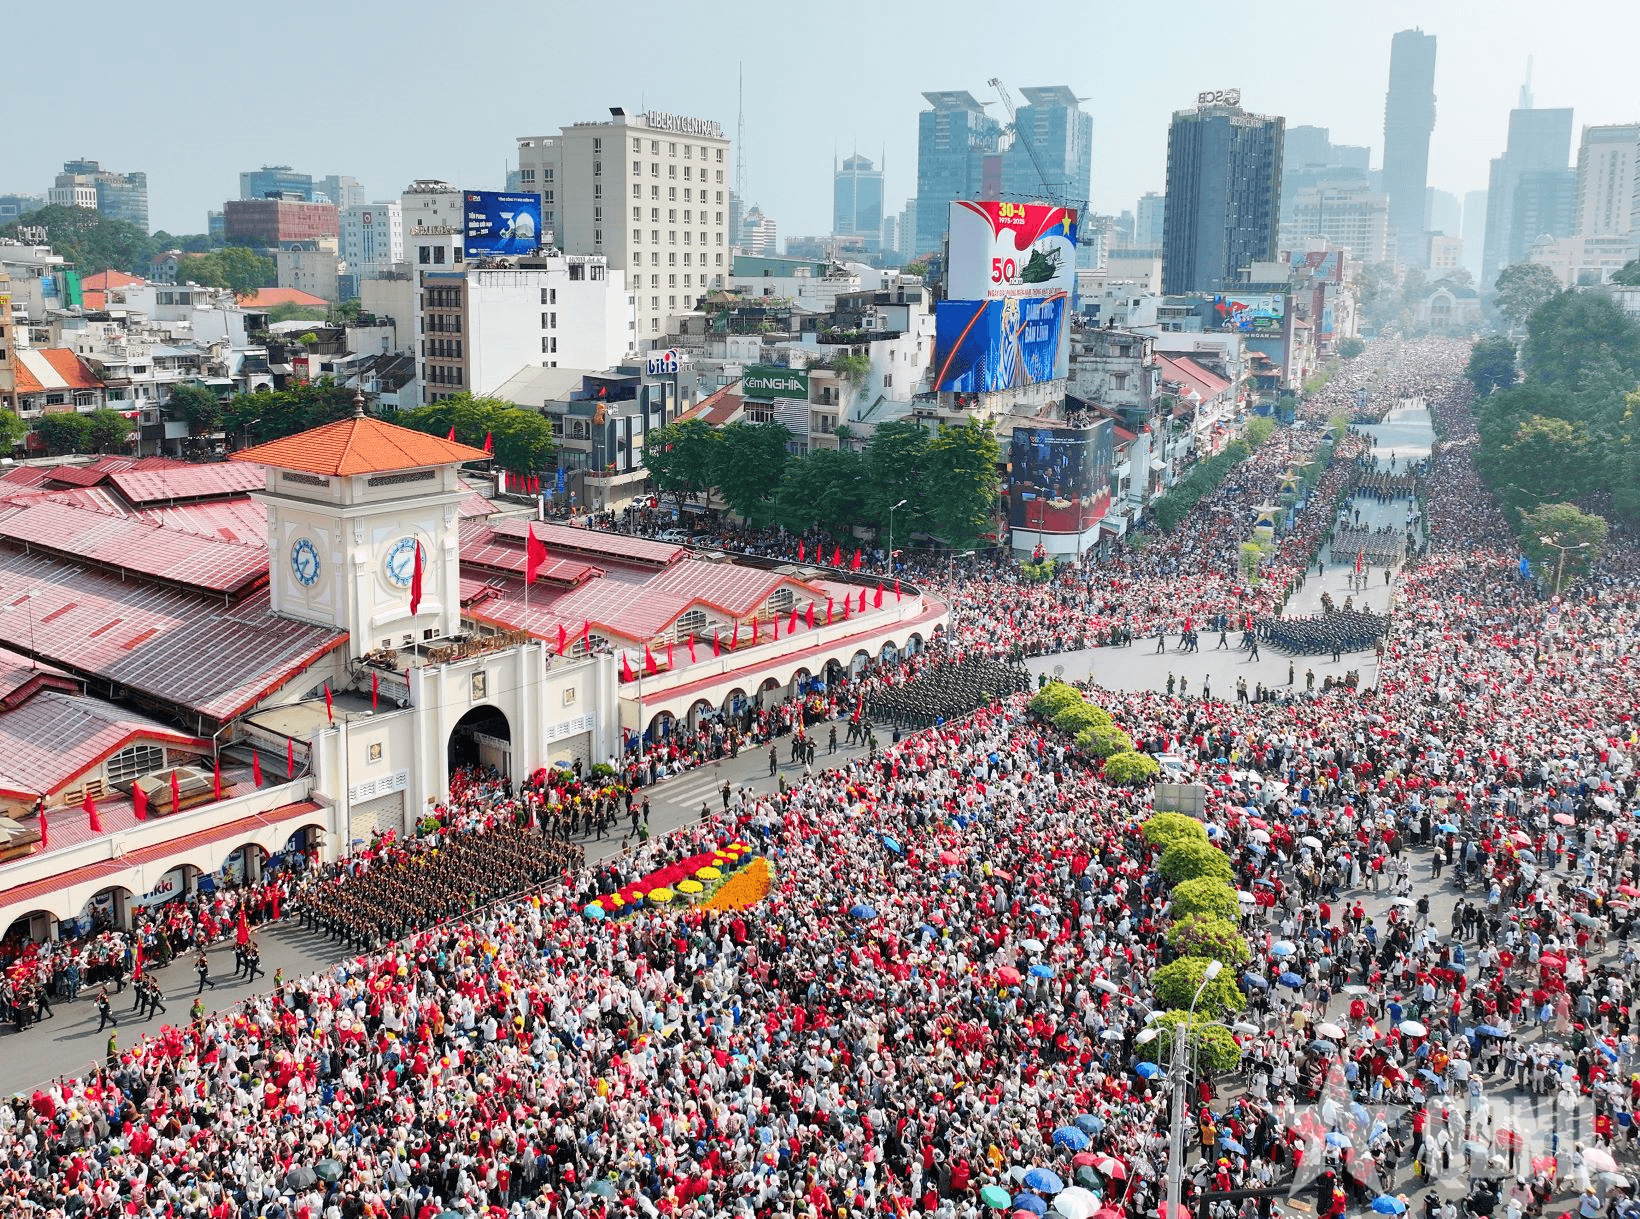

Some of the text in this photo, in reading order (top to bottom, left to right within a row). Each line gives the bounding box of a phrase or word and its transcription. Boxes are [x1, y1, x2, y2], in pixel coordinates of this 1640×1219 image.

[648, 109, 681, 134] LIBERTY
[998, 202, 1025, 218] 30-4
[499, 211, 535, 239] 30
[991, 257, 1016, 284] 50
